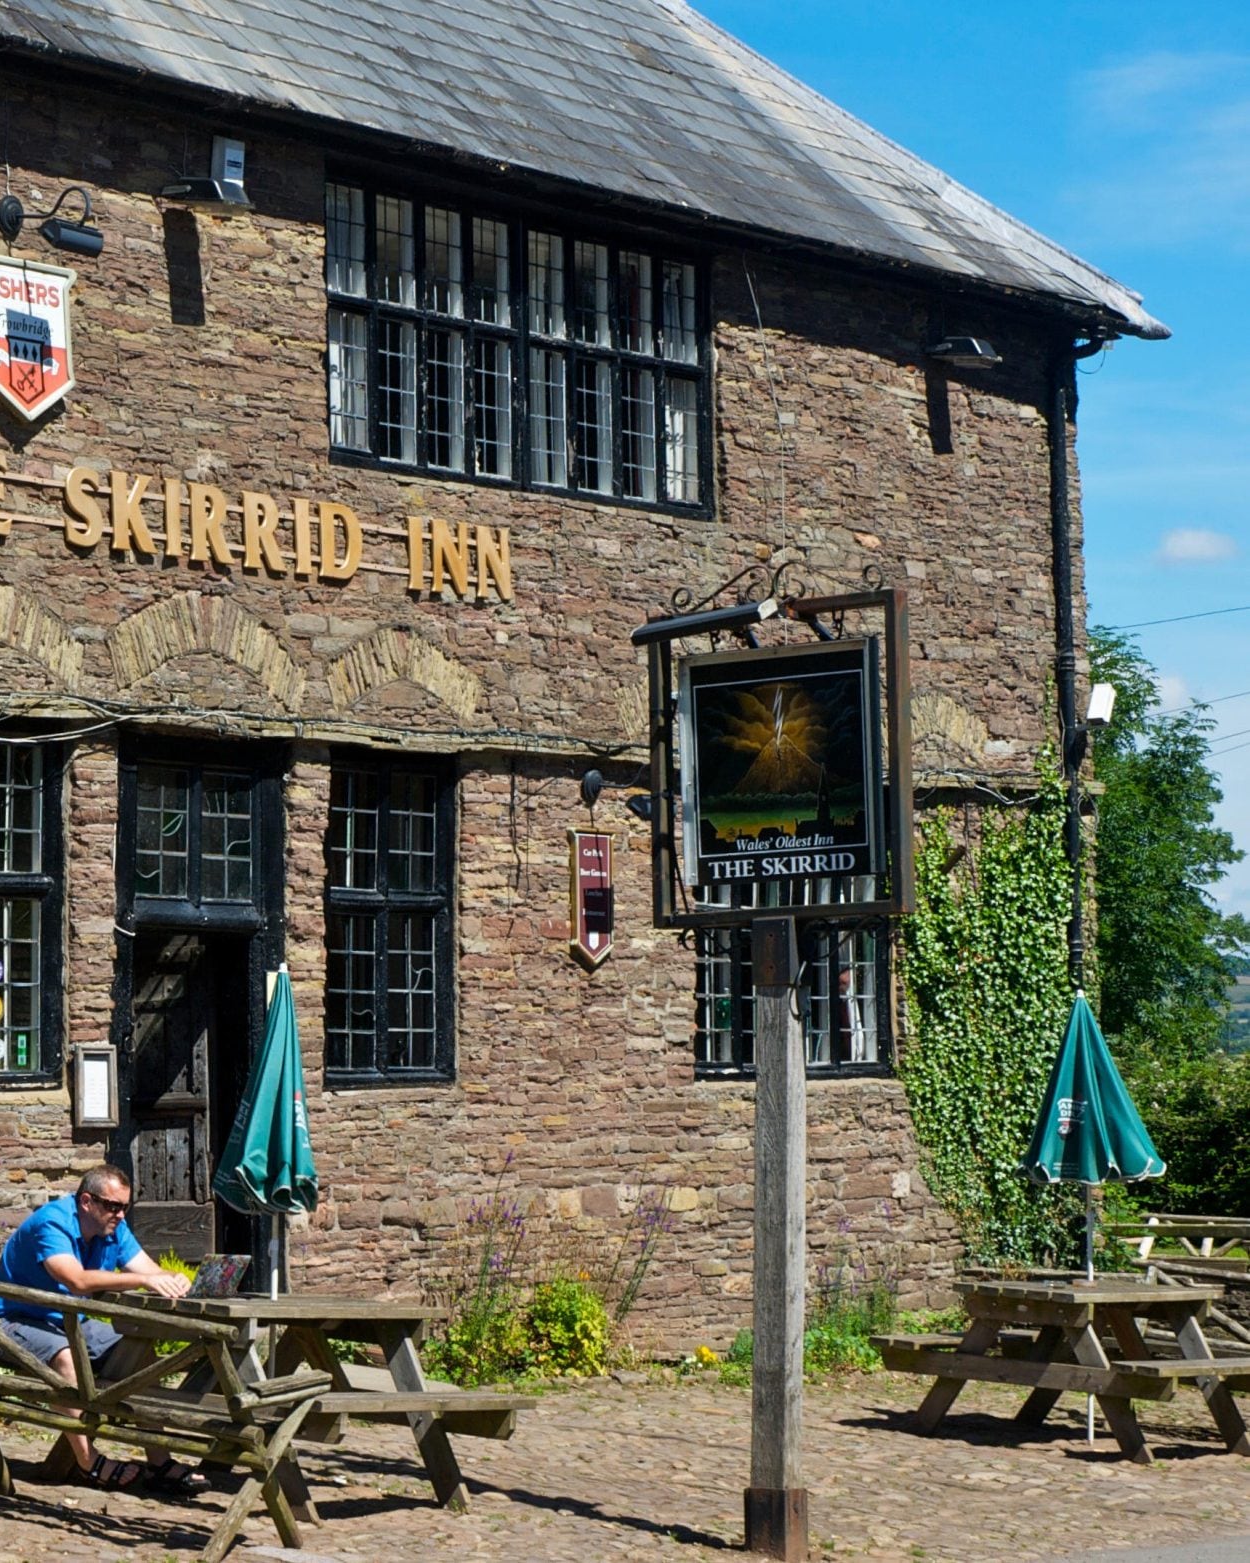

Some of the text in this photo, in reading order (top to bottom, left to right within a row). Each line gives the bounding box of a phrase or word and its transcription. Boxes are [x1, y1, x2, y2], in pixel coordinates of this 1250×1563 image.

[64, 465, 363, 580] SKIRRID
[406, 516, 512, 600] INN
[775, 835, 812, 849] Oldest
[814, 834, 834, 846] Inn
[708, 852, 856, 879] THE SKIRRID
